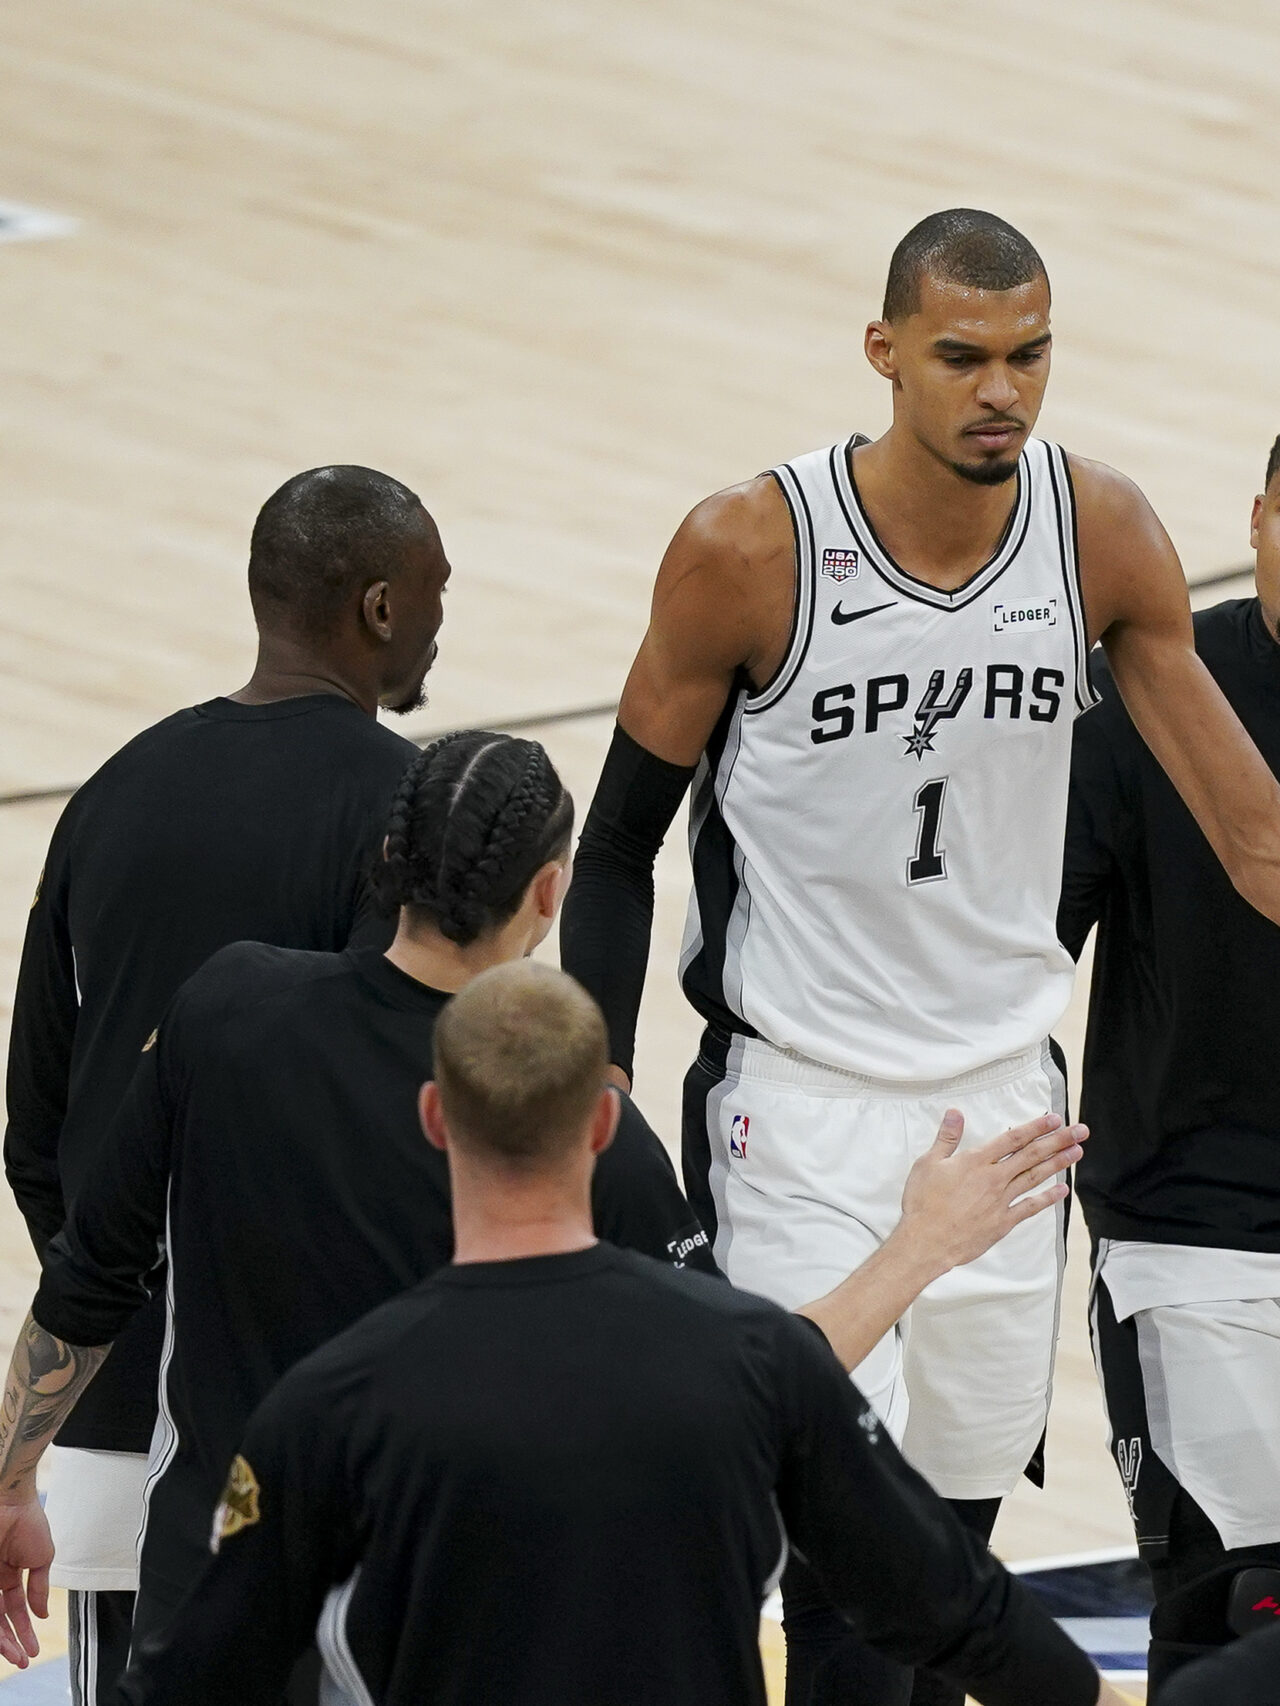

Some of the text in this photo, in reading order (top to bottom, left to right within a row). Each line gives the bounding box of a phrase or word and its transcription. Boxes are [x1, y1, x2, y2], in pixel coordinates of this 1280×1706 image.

[824, 551, 857, 562] USA
[822, 565, 858, 577] 250
[1002, 606, 1051, 624] LEDGER
[810, 664, 1065, 762] SPURS
[907, 777, 948, 885] 1
[676, 1230, 709, 1258] LEDGE
